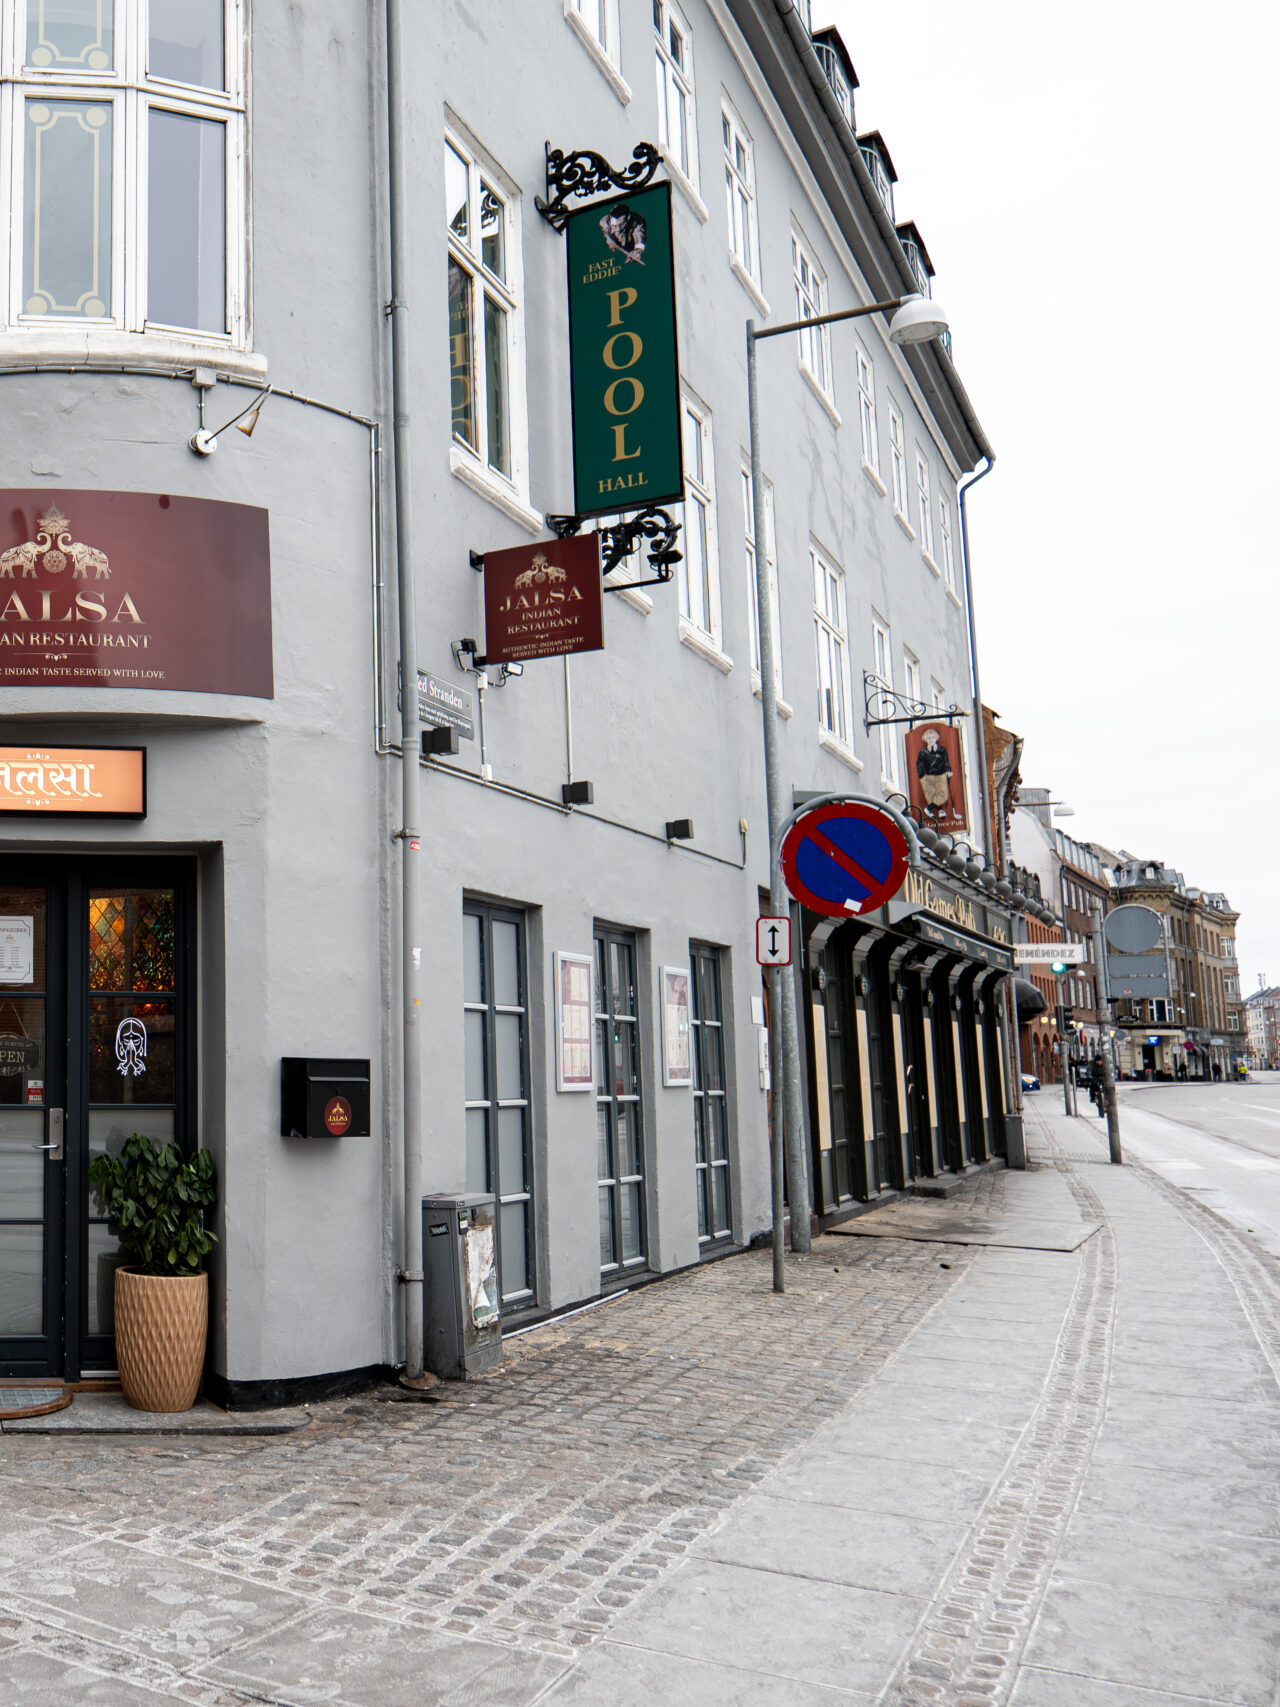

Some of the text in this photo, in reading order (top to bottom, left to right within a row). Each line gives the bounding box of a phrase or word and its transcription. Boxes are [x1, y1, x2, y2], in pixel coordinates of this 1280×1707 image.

[589, 257, 616, 272] FAST
[603, 287, 644, 462] POOL
[599, 472, 648, 493] HALL
[500, 585, 584, 611] JALSA
[522, 607, 561, 620] INDIAN
[508, 616, 580, 634] RESTAURANT
[30, 632, 151, 648] RESTAURANT
[502, 636, 584, 653] AUTHENTIC INDIAN TASTE
[512, 644, 574, 658] SERVED WITH LOVE
[5, 668, 39, 676] INDIAN
[41, 667, 72, 675] TASTE
[74, 668, 111, 677] SERVED
[113, 669, 138, 678] WITH
[141, 670, 164, 679] LOVE
[417, 675, 463, 709] ed Stranden
[904, 868, 976, 931] Old Games Pub
